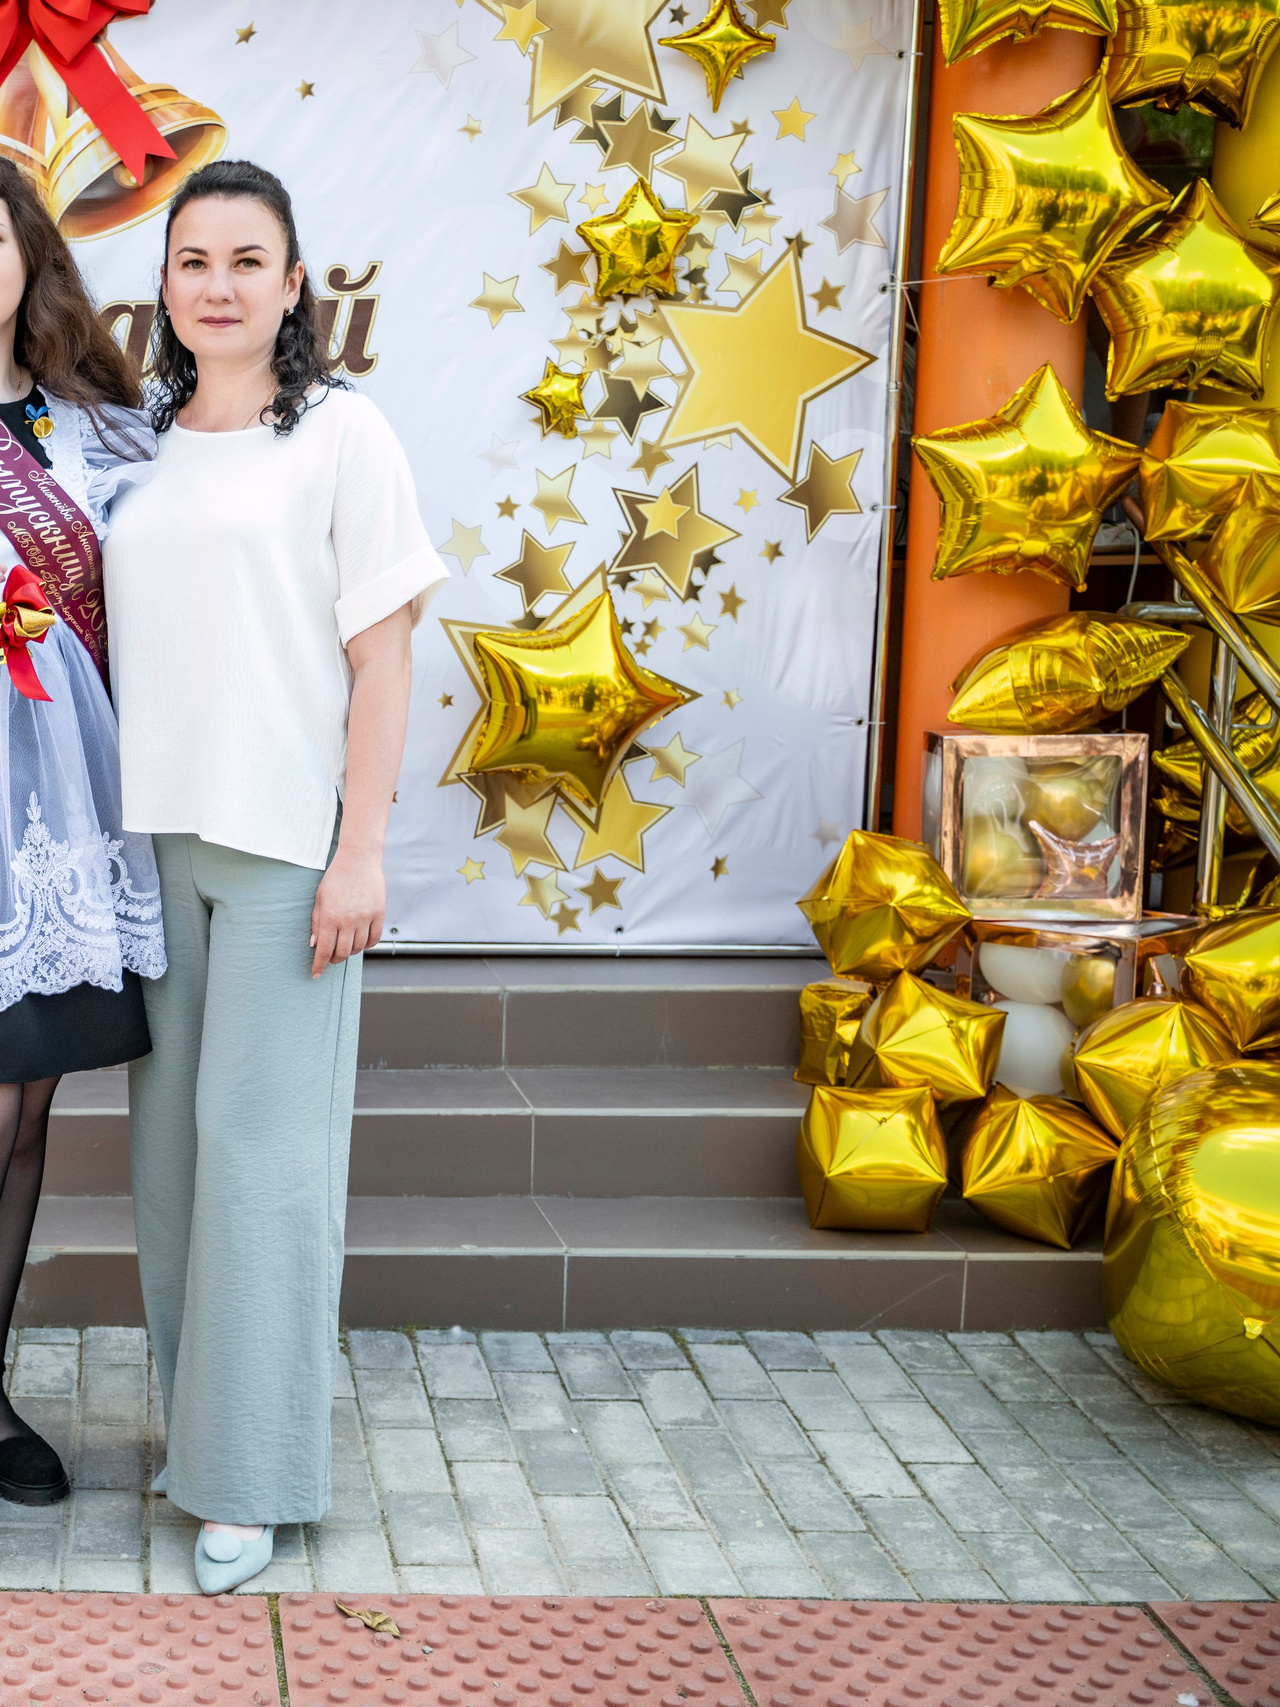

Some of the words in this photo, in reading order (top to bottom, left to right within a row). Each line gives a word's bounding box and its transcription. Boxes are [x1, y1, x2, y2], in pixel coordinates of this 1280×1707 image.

[6, 521, 50, 567] МБОУ
[27, 470, 77, 522] Нижнёва
[71, 520, 96, 580] Анастасия
